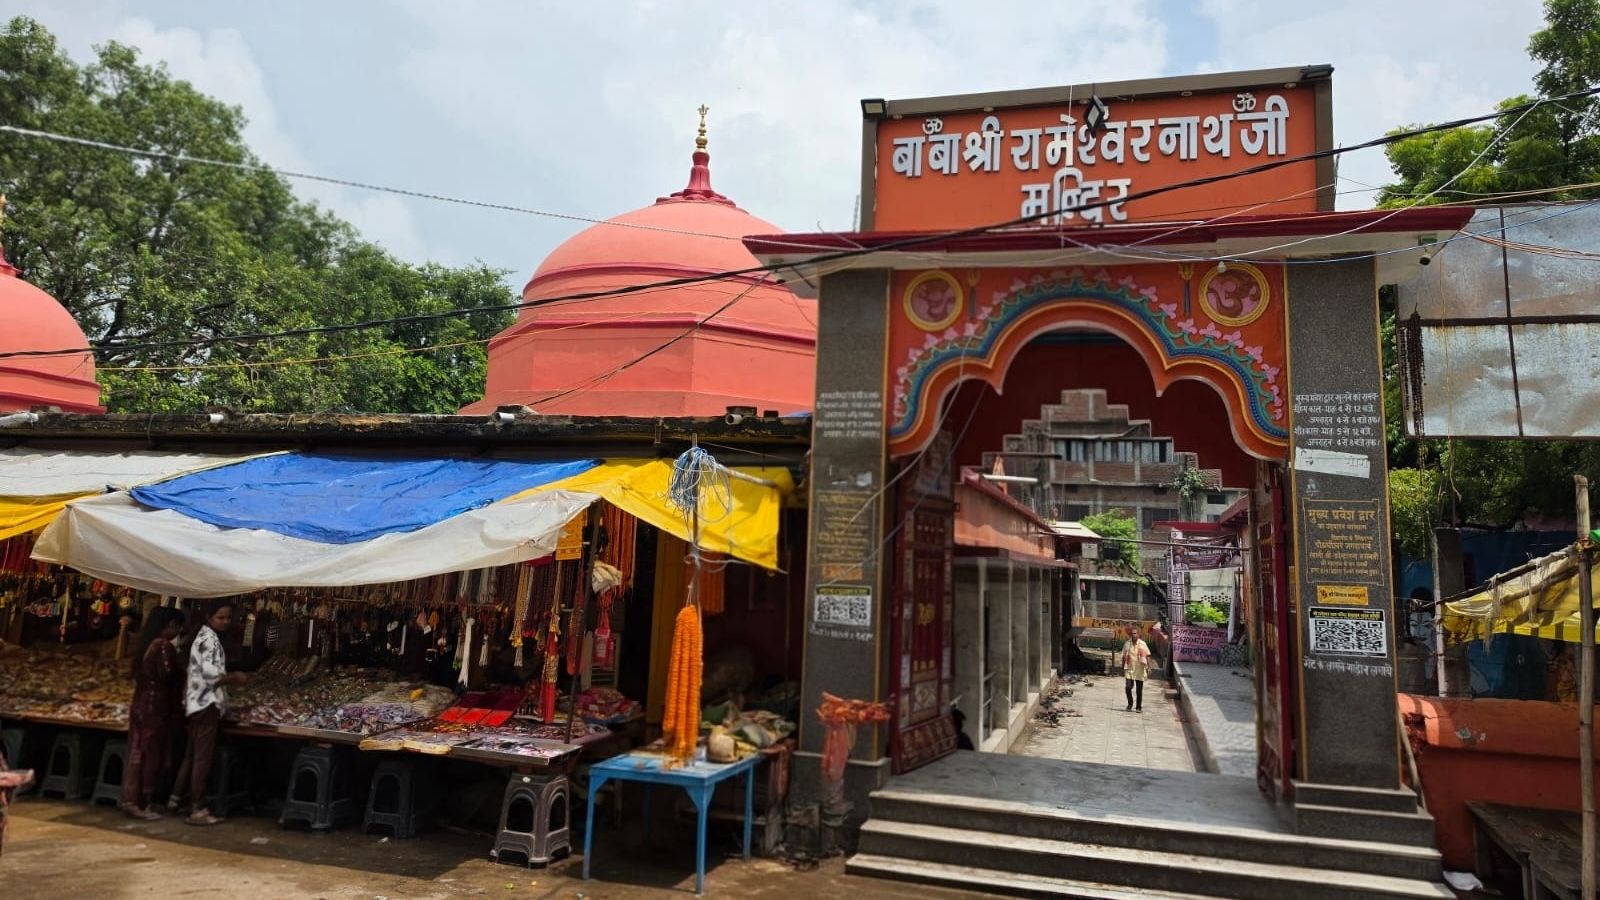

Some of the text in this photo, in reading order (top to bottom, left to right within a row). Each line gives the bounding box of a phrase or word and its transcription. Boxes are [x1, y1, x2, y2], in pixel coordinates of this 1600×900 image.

[893, 133, 961, 177] बाबा
[962, 115, 1004, 172] श्री
[1237, 94, 1290, 156] जी
[1308, 507, 1376, 523] मुख्य प्रवेश द्वार
